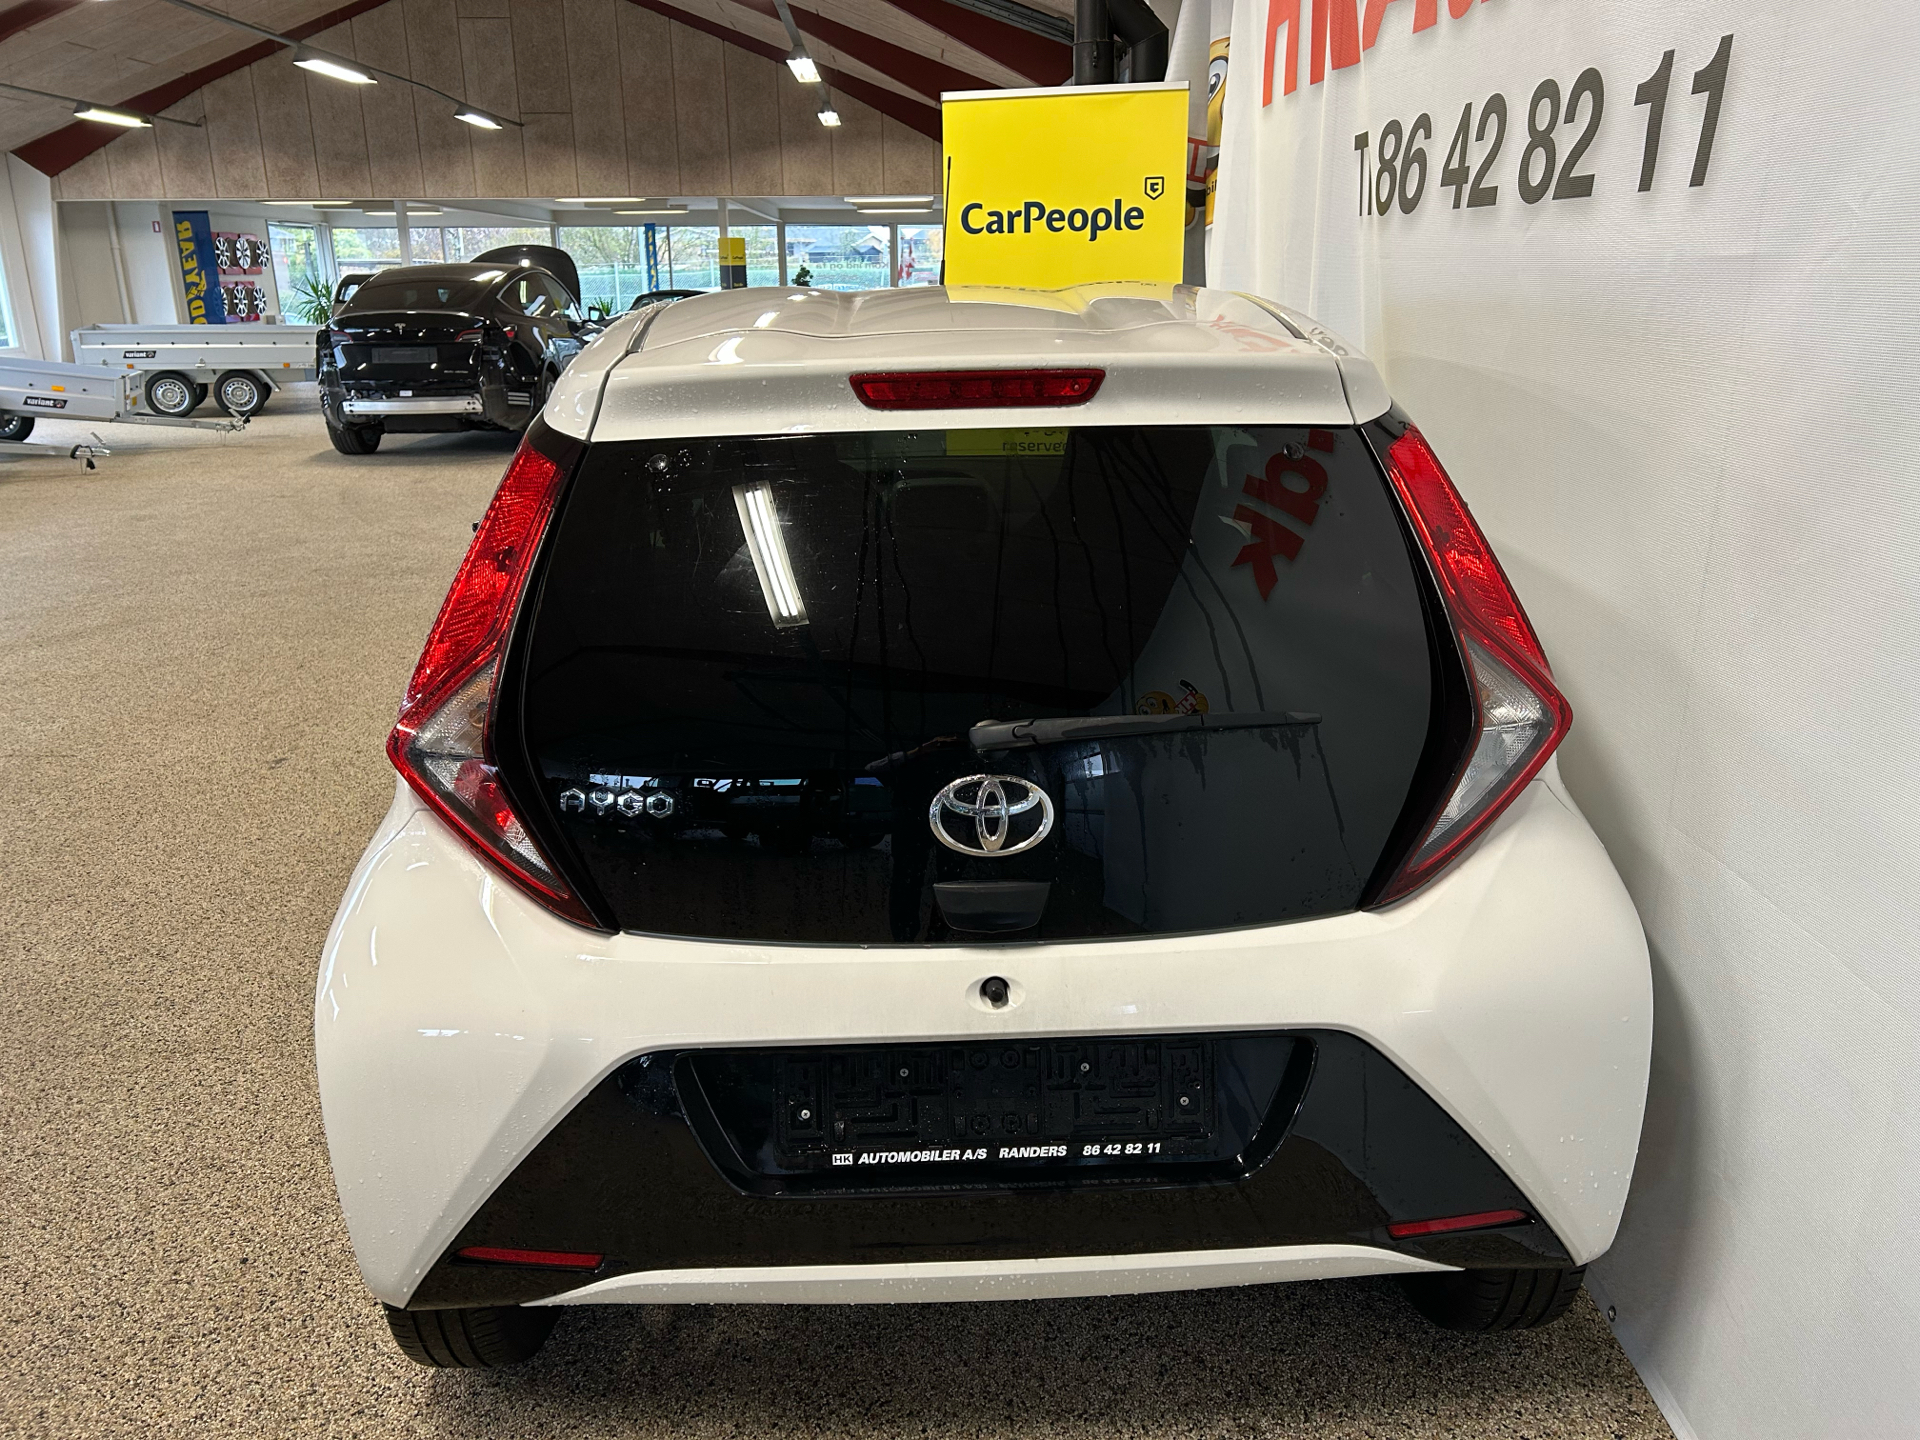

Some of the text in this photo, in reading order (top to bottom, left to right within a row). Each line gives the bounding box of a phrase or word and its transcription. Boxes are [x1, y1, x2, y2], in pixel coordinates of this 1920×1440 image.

[1376, 112, 1432, 216] 86
[1440, 92, 1507, 210] 42
[1518, 67, 1605, 205] 82
[1633, 33, 1734, 192] 11
[960, 198, 1144, 241] CarPeople
[26, 398, 54, 407] variant
[559, 787, 674, 818] AYGO
[833, 1143, 1161, 1165] HK AUTOMOBILER A/S RANDERS 86 42 82 11
